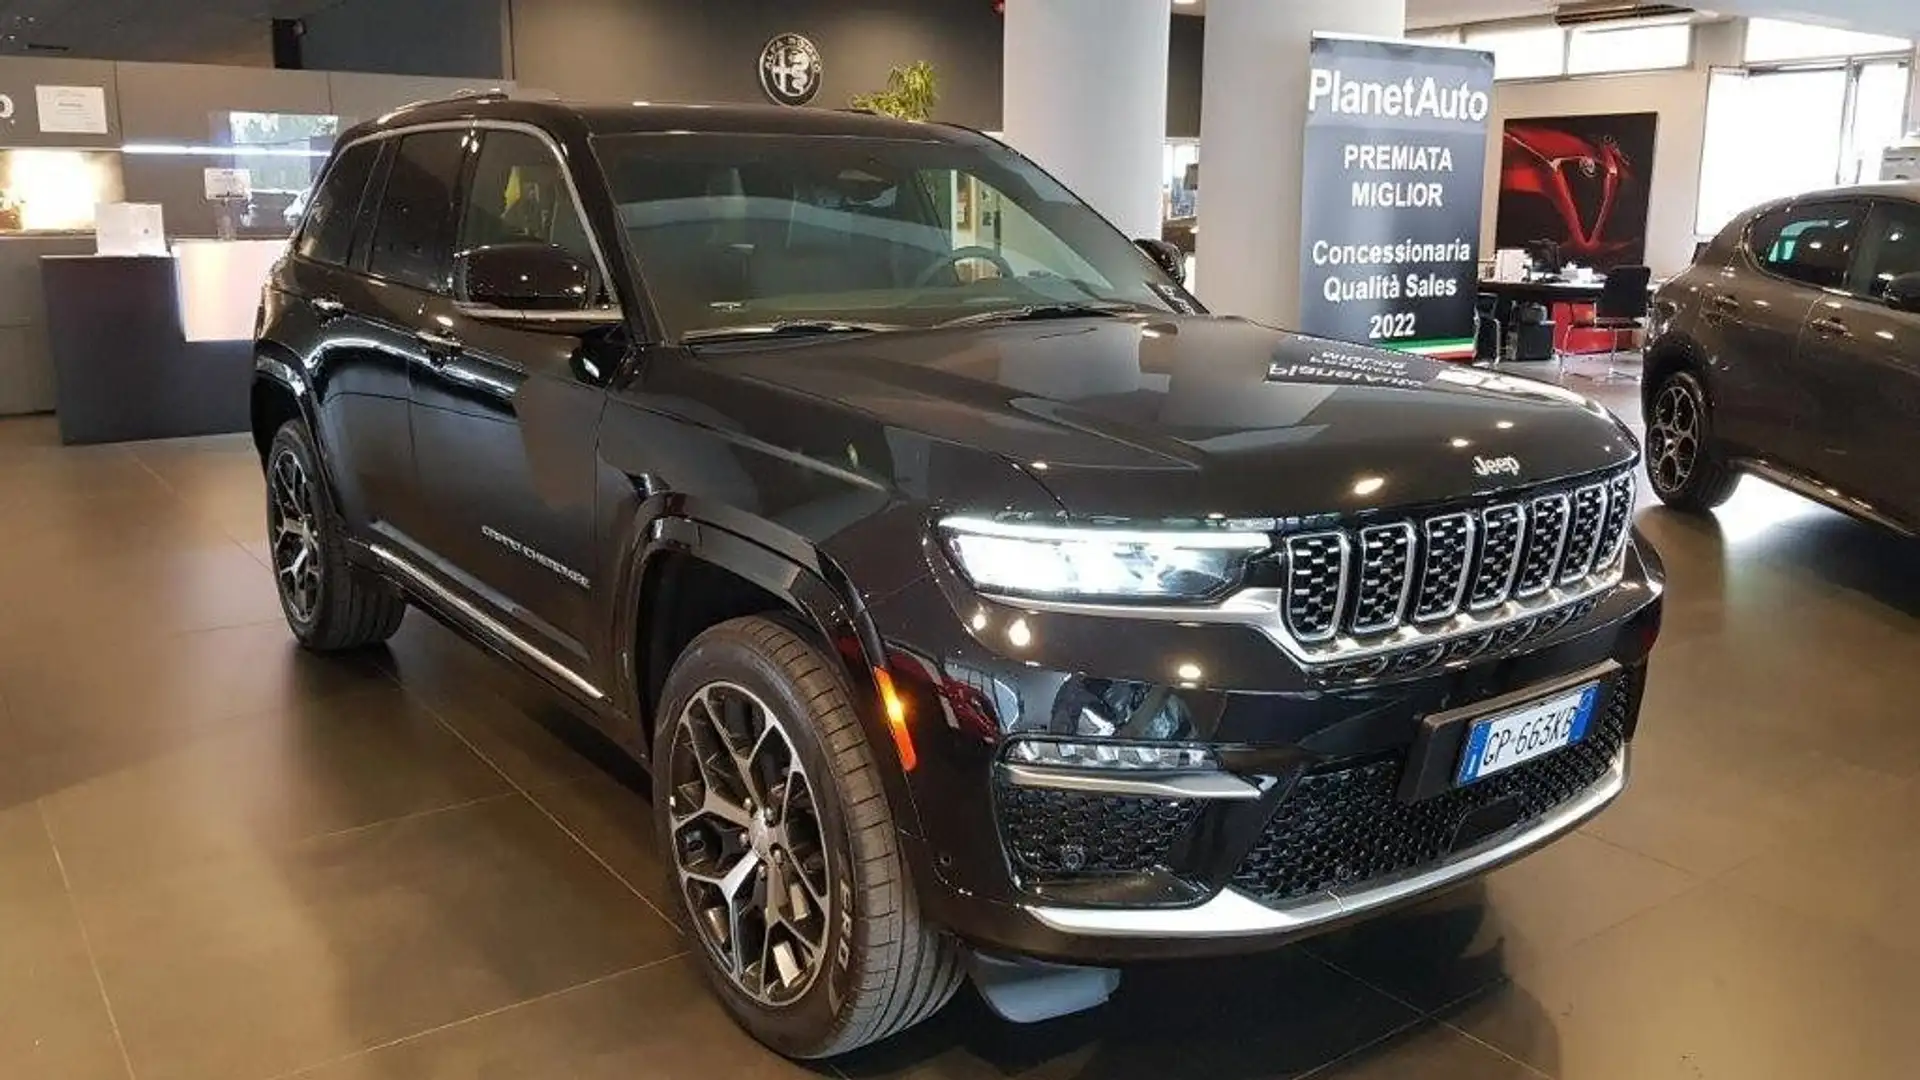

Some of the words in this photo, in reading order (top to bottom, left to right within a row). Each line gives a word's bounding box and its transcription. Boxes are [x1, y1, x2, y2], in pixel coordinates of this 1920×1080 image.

[1308, 68, 1489, 121] PlanetAuto
[1344, 144, 1453, 171] PREMIATA
[1351, 181, 1444, 207] MIGLIOR
[1312, 238, 1471, 265] Concessionaria
[1323, 274, 1400, 303] Qualità
[1405, 273, 1458, 297] Sales
[1368, 312, 1416, 339] 2022
[1473, 455, 1520, 476] Jeep
